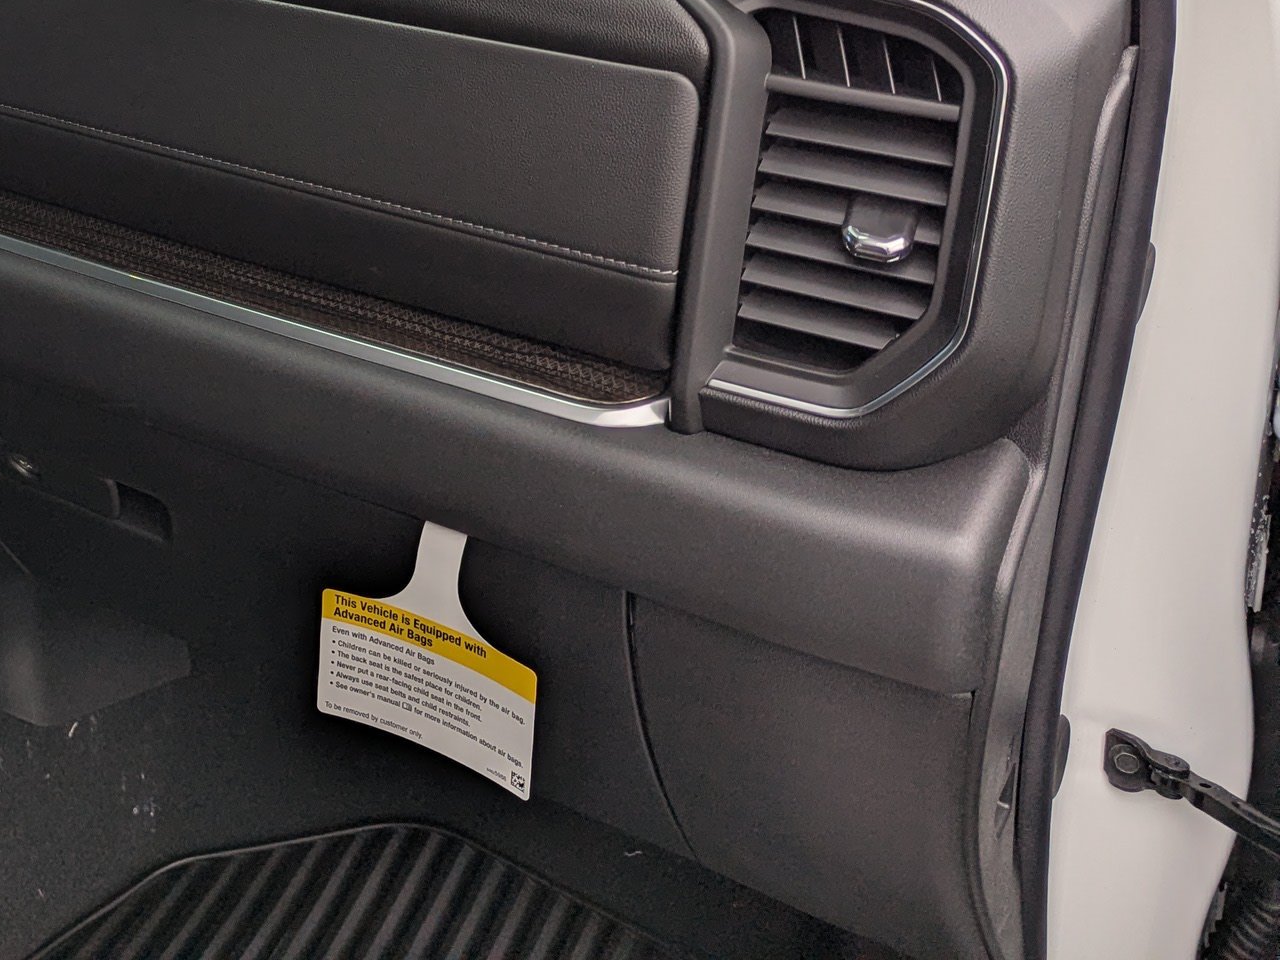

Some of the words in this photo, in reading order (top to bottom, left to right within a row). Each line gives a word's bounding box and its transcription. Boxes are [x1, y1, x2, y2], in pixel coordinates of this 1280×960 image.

[332, 625, 350, 636] Even
[351, 631, 367, 641] with
[368, 636, 404, 653] Advanced
[405, 648, 416, 657] Air
[417, 654, 435, 665] Bags
[333, 607, 386, 630] Advanced
[388, 623, 404, 635] Air
[407, 628, 433, 647] Bags
[334, 594, 357, 609] This
[360, 600, 399, 621] Vehicle
[401, 613, 411, 626] is
[413, 618, 462, 647] Equipped
[464, 641, 487, 658] with
[335, 671, 360, 683] Always
[361, 679, 374, 687] use
[374, 683, 389, 693] seat
[390, 687, 407, 699] belts
[407, 695, 420, 704] and
[421, 700, 438, 712] child
[438, 708, 471, 727] restraints.
[336, 660, 356, 671] Never
[357, 666, 369, 675] put
[375, 673, 412, 691] rear-facing
[413, 685, 430, 698] child
[430, 693, 445, 704] seat
[446, 699, 452, 707] in
[453, 702, 464, 713] the
[465, 708, 482, 723] front.
[337, 640, 367, 654] Children
[368, 649, 381, 658] can
[382, 653, 392, 662] be
[393, 657, 412, 669] killed
[413, 664, 421, 672] or
[422, 668, 453, 687] seriously
[454, 681, 478, 698] injured
[479, 691, 487, 703] by
[488, 698, 500, 710] the
[501, 706, 510, 715] air
[511, 711, 525, 725] bag.
[338, 650, 350, 659] The
[351, 654, 367, 664] back
[368, 660, 383, 670] seat
[384, 664, 390, 672] is
[391, 667, 403, 676] the
[404, 672, 424, 685] safest
[425, 680, 443, 692] place
[444, 687, 454, 697] for
[454, 693, 482, 711] children.
[325, 701, 333, 709] To
[333, 703, 342, 711] be
[343, 706, 370, 719] removed
[371, 714, 378, 723] by
[380, 718, 408, 733] customer
[409, 728, 423, 740] only.
[335, 681, 348, 691] See
[349, 687, 376, 699] owner's
[376, 694, 401, 707] manual
[414, 706, 423, 716] for
[424, 712, 441, 724] more
[442, 719, 478, 742] information
[478, 738, 497, 752] about
[497, 748, 507, 757] air
[507, 753, 523, 769] bags.
